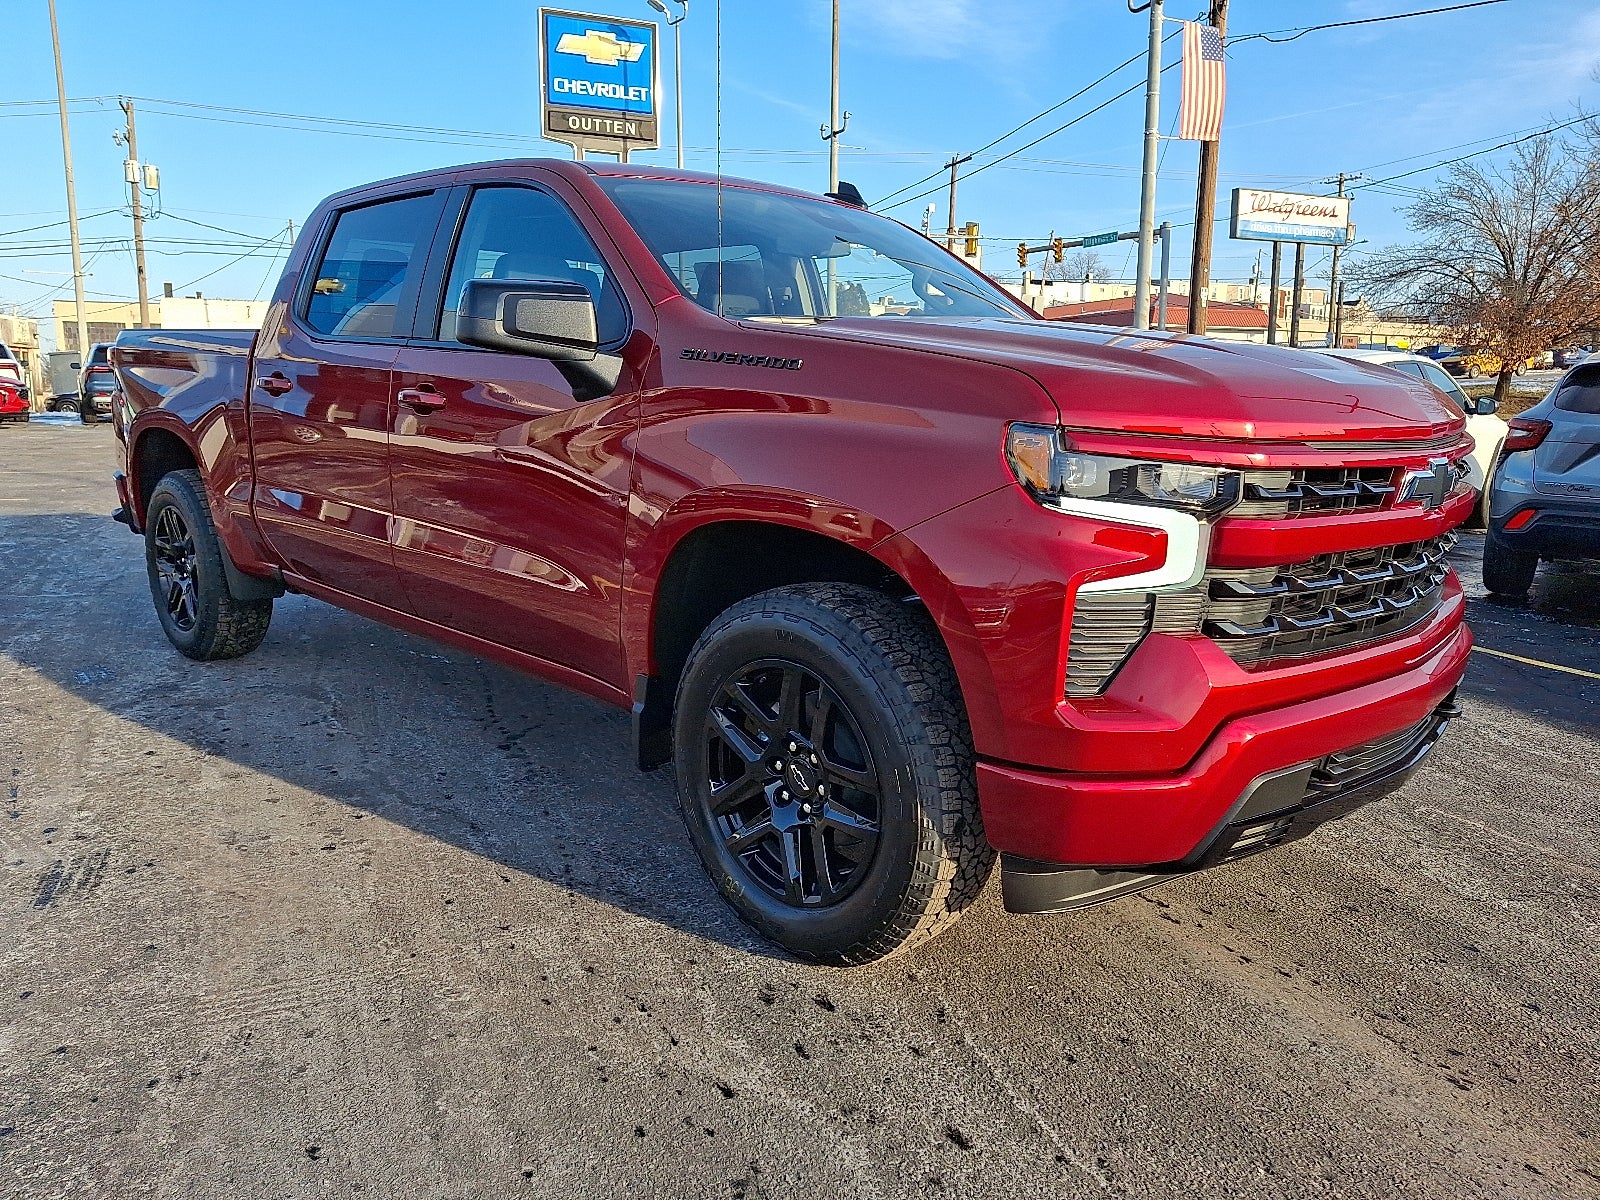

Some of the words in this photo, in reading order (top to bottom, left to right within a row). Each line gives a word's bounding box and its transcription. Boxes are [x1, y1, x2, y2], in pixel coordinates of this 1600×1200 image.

[553, 77, 649, 101] CHEVROLET
[568, 115, 637, 135] OUTTEN
[1250, 192, 1339, 221] Walgreens
[1251, 222, 1273, 233] drive
[1293, 227, 1336, 240] pharmacy
[679, 348, 804, 370] SILVERADO
